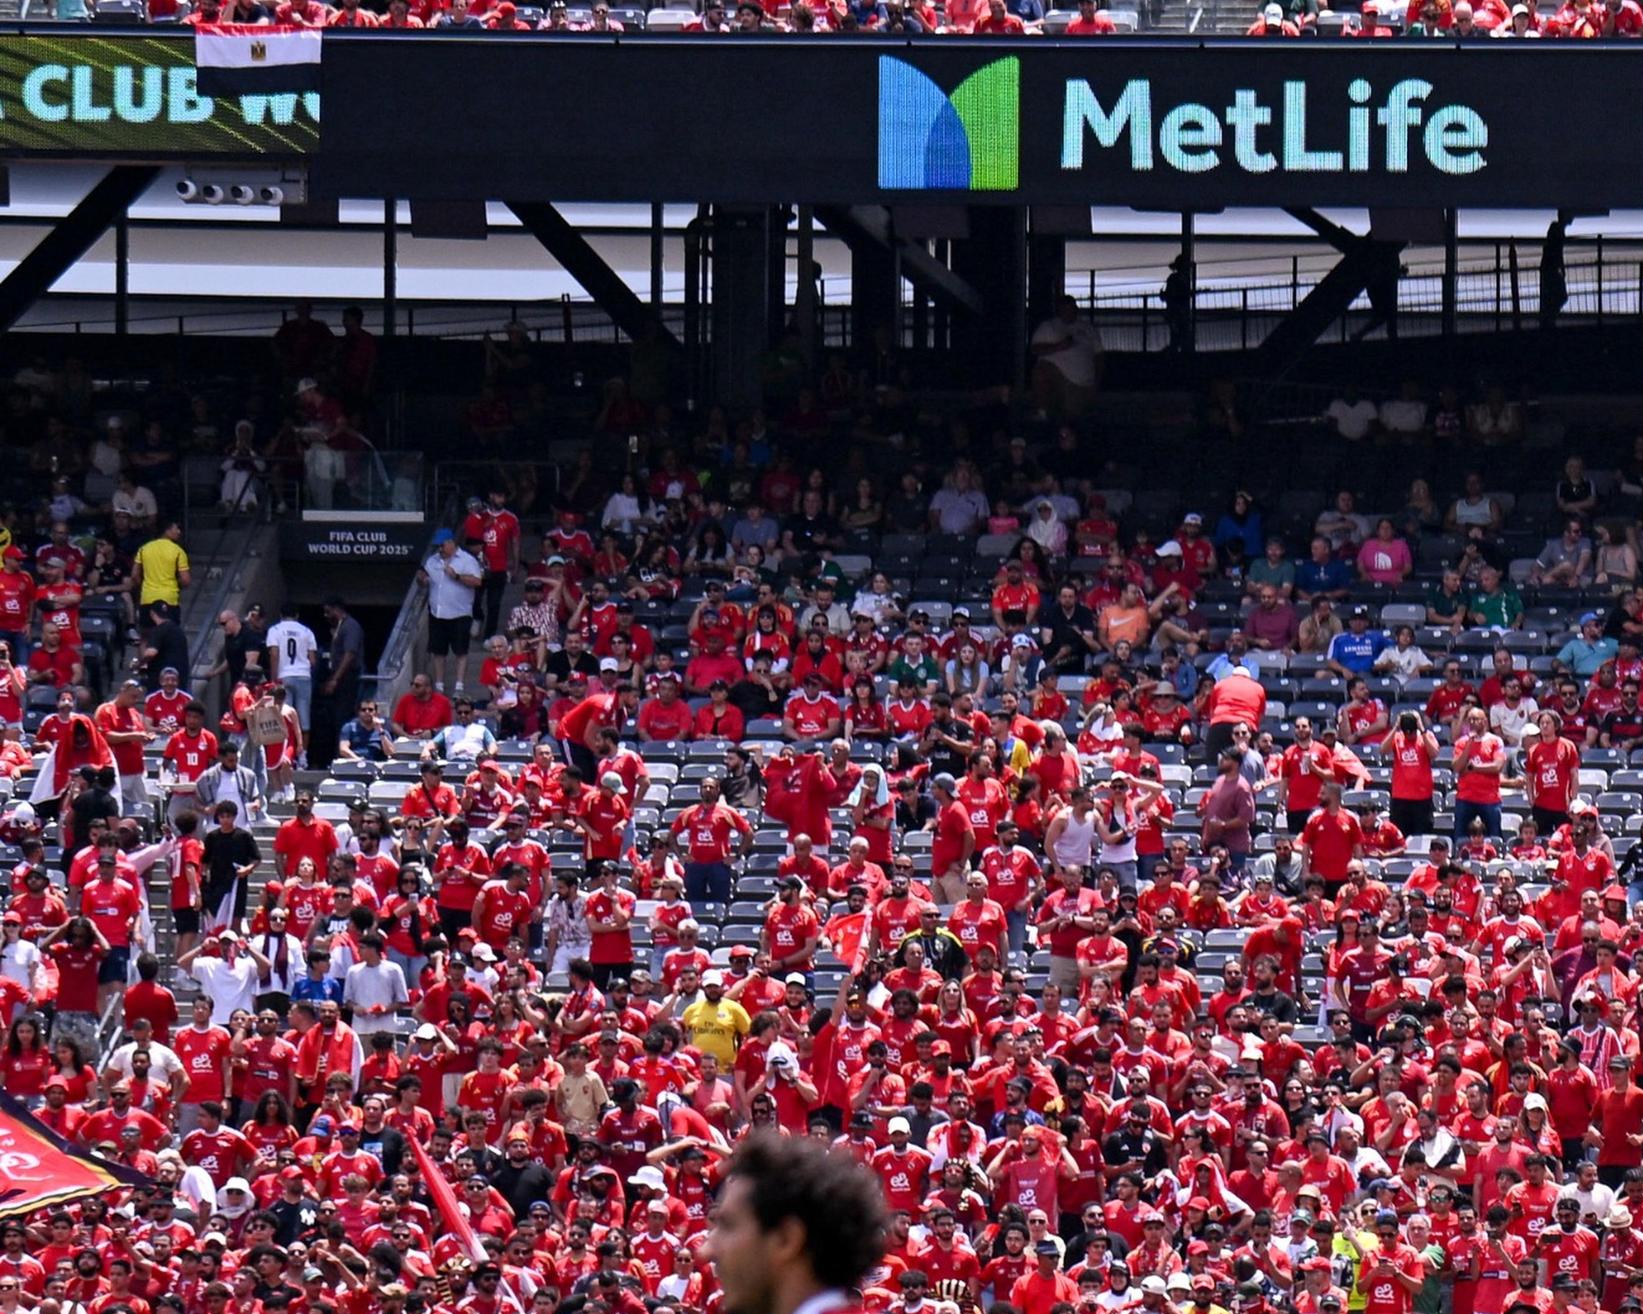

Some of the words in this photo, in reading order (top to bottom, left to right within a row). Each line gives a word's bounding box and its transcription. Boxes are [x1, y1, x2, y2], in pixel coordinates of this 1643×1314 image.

[22, 64, 214, 123] CLUB
[1061, 78, 1489, 174] MetLife
[330, 531, 354, 542] FIFA
[357, 532, 387, 542] CLUB
[308, 544, 351, 554] WORLD
[353, 544, 377, 554] CUP
[287, 638, 296, 664] 9
[187, 752, 198, 765] 10
